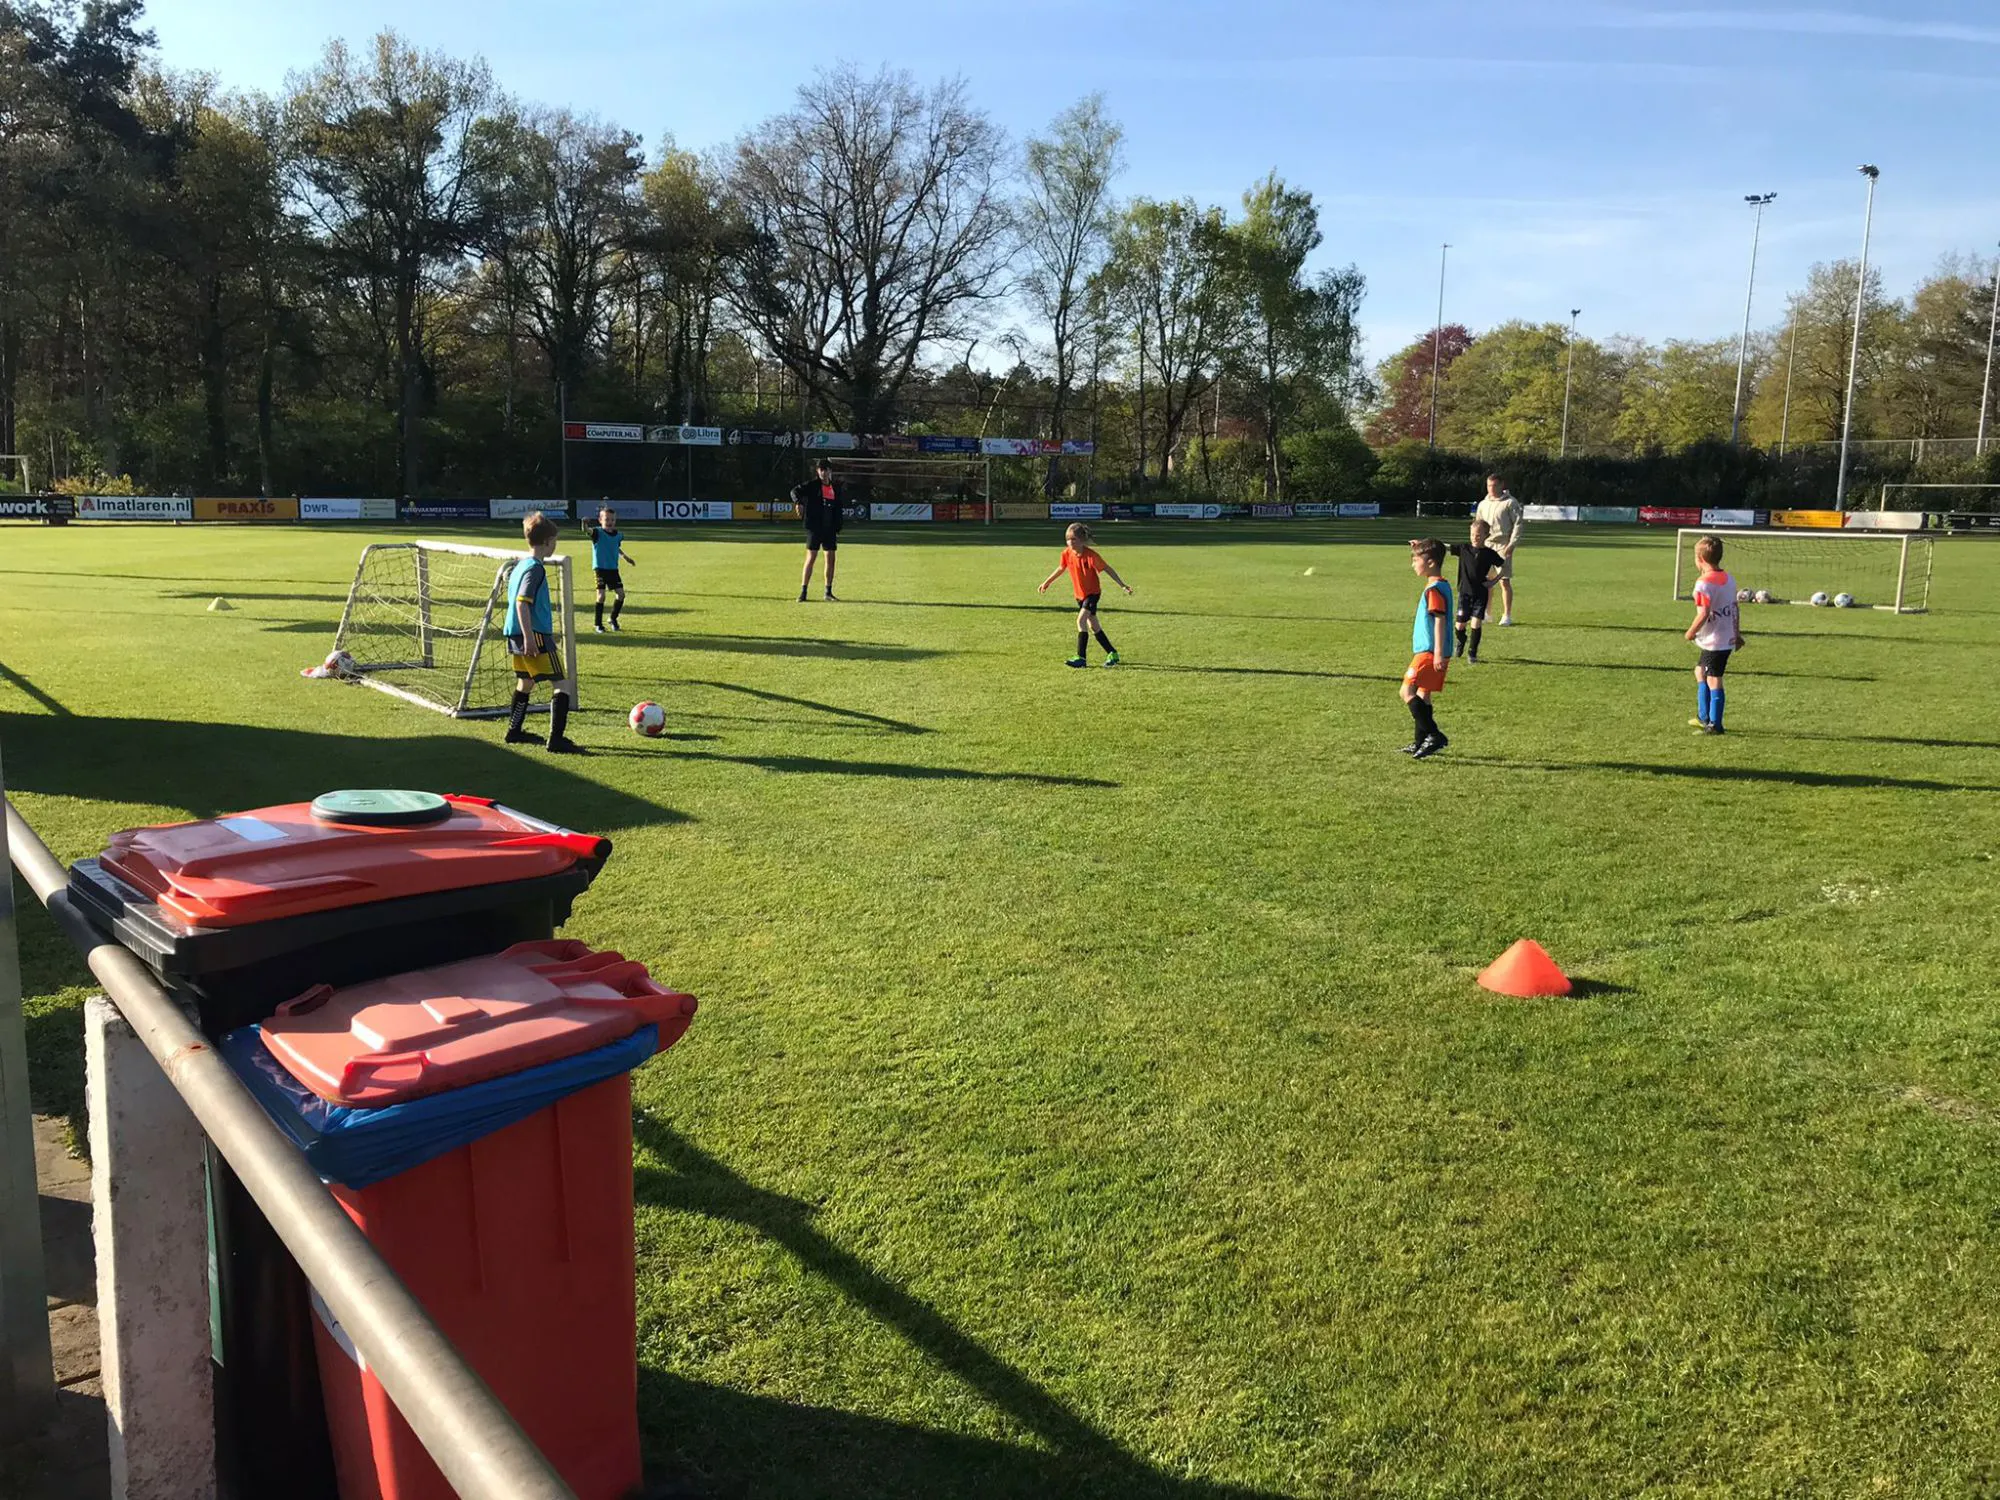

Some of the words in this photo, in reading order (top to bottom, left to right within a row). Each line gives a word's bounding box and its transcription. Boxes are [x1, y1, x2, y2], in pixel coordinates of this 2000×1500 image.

[697, 429, 719, 438] Libra
[81, 498, 190, 511] Almatlaren.nl
[217, 502, 275, 514] PRAXIS
[303, 504, 329, 513] DWR
